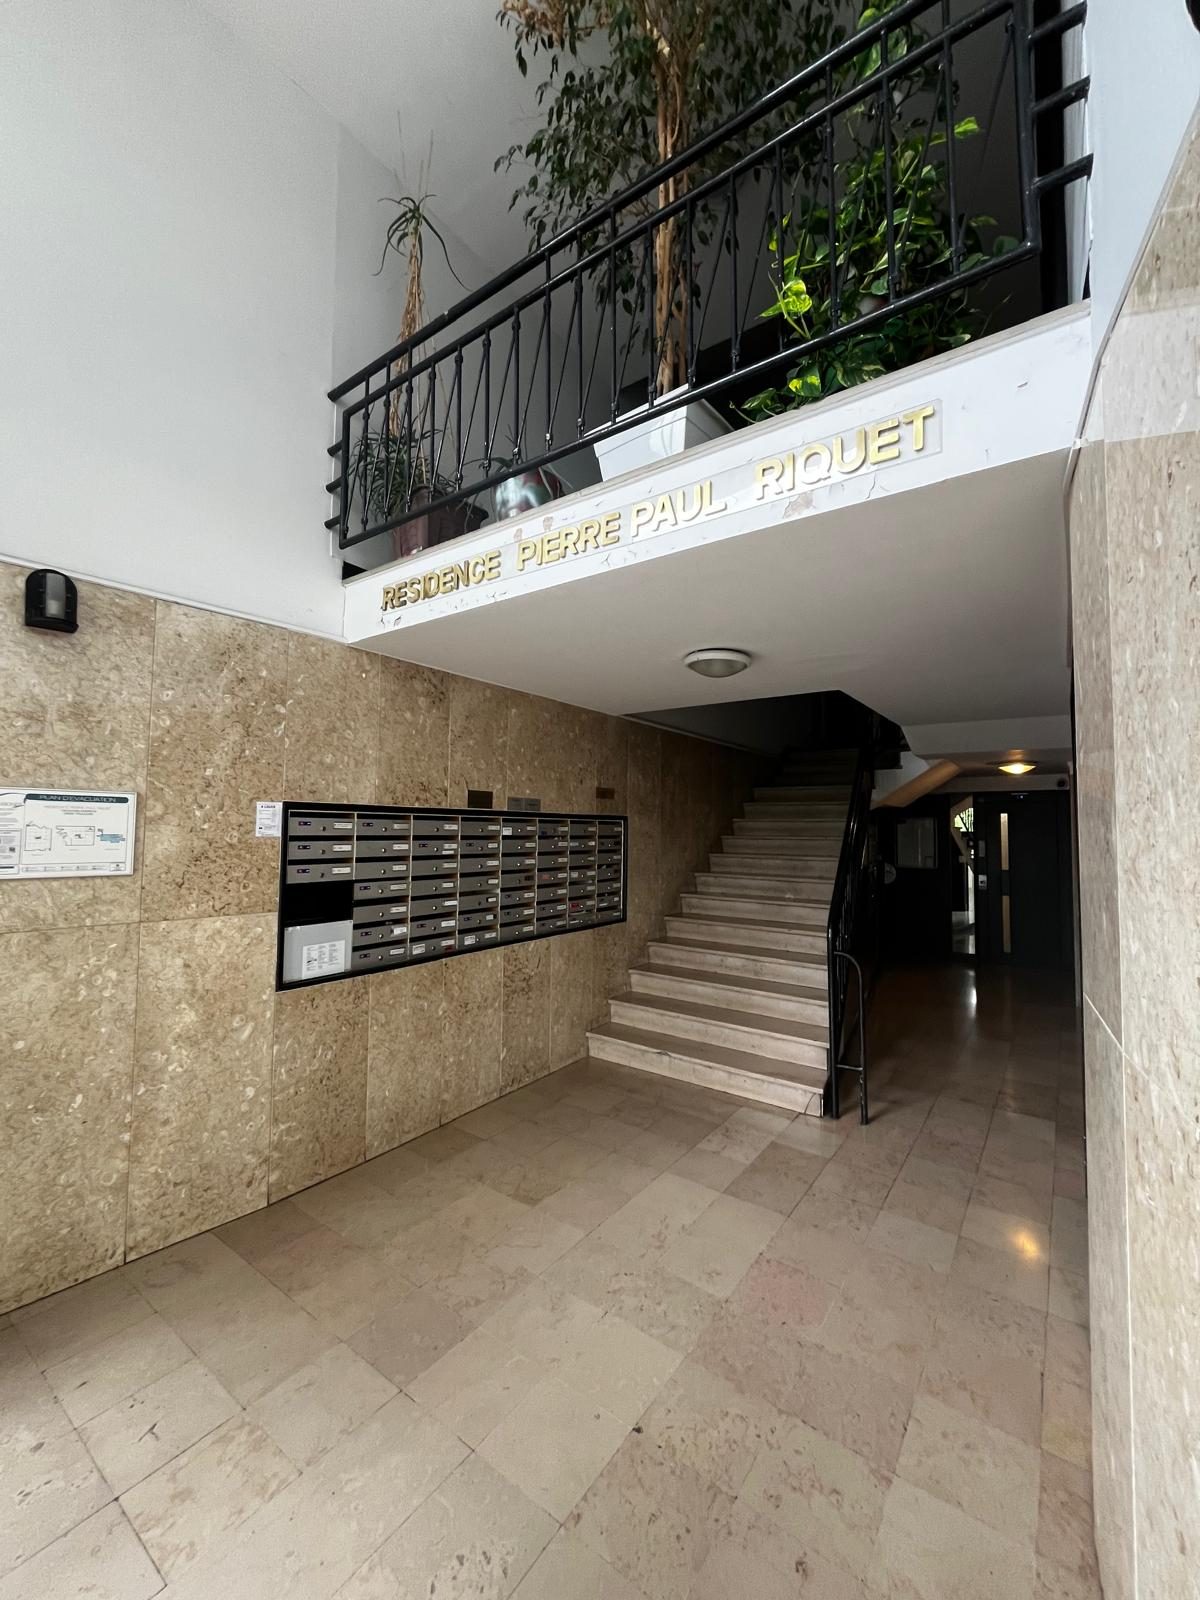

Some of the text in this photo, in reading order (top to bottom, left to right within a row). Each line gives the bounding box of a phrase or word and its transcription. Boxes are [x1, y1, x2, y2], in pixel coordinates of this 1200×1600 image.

[382, 405, 935, 611] RESIDENCE PIERRE PAUL RIQUET
